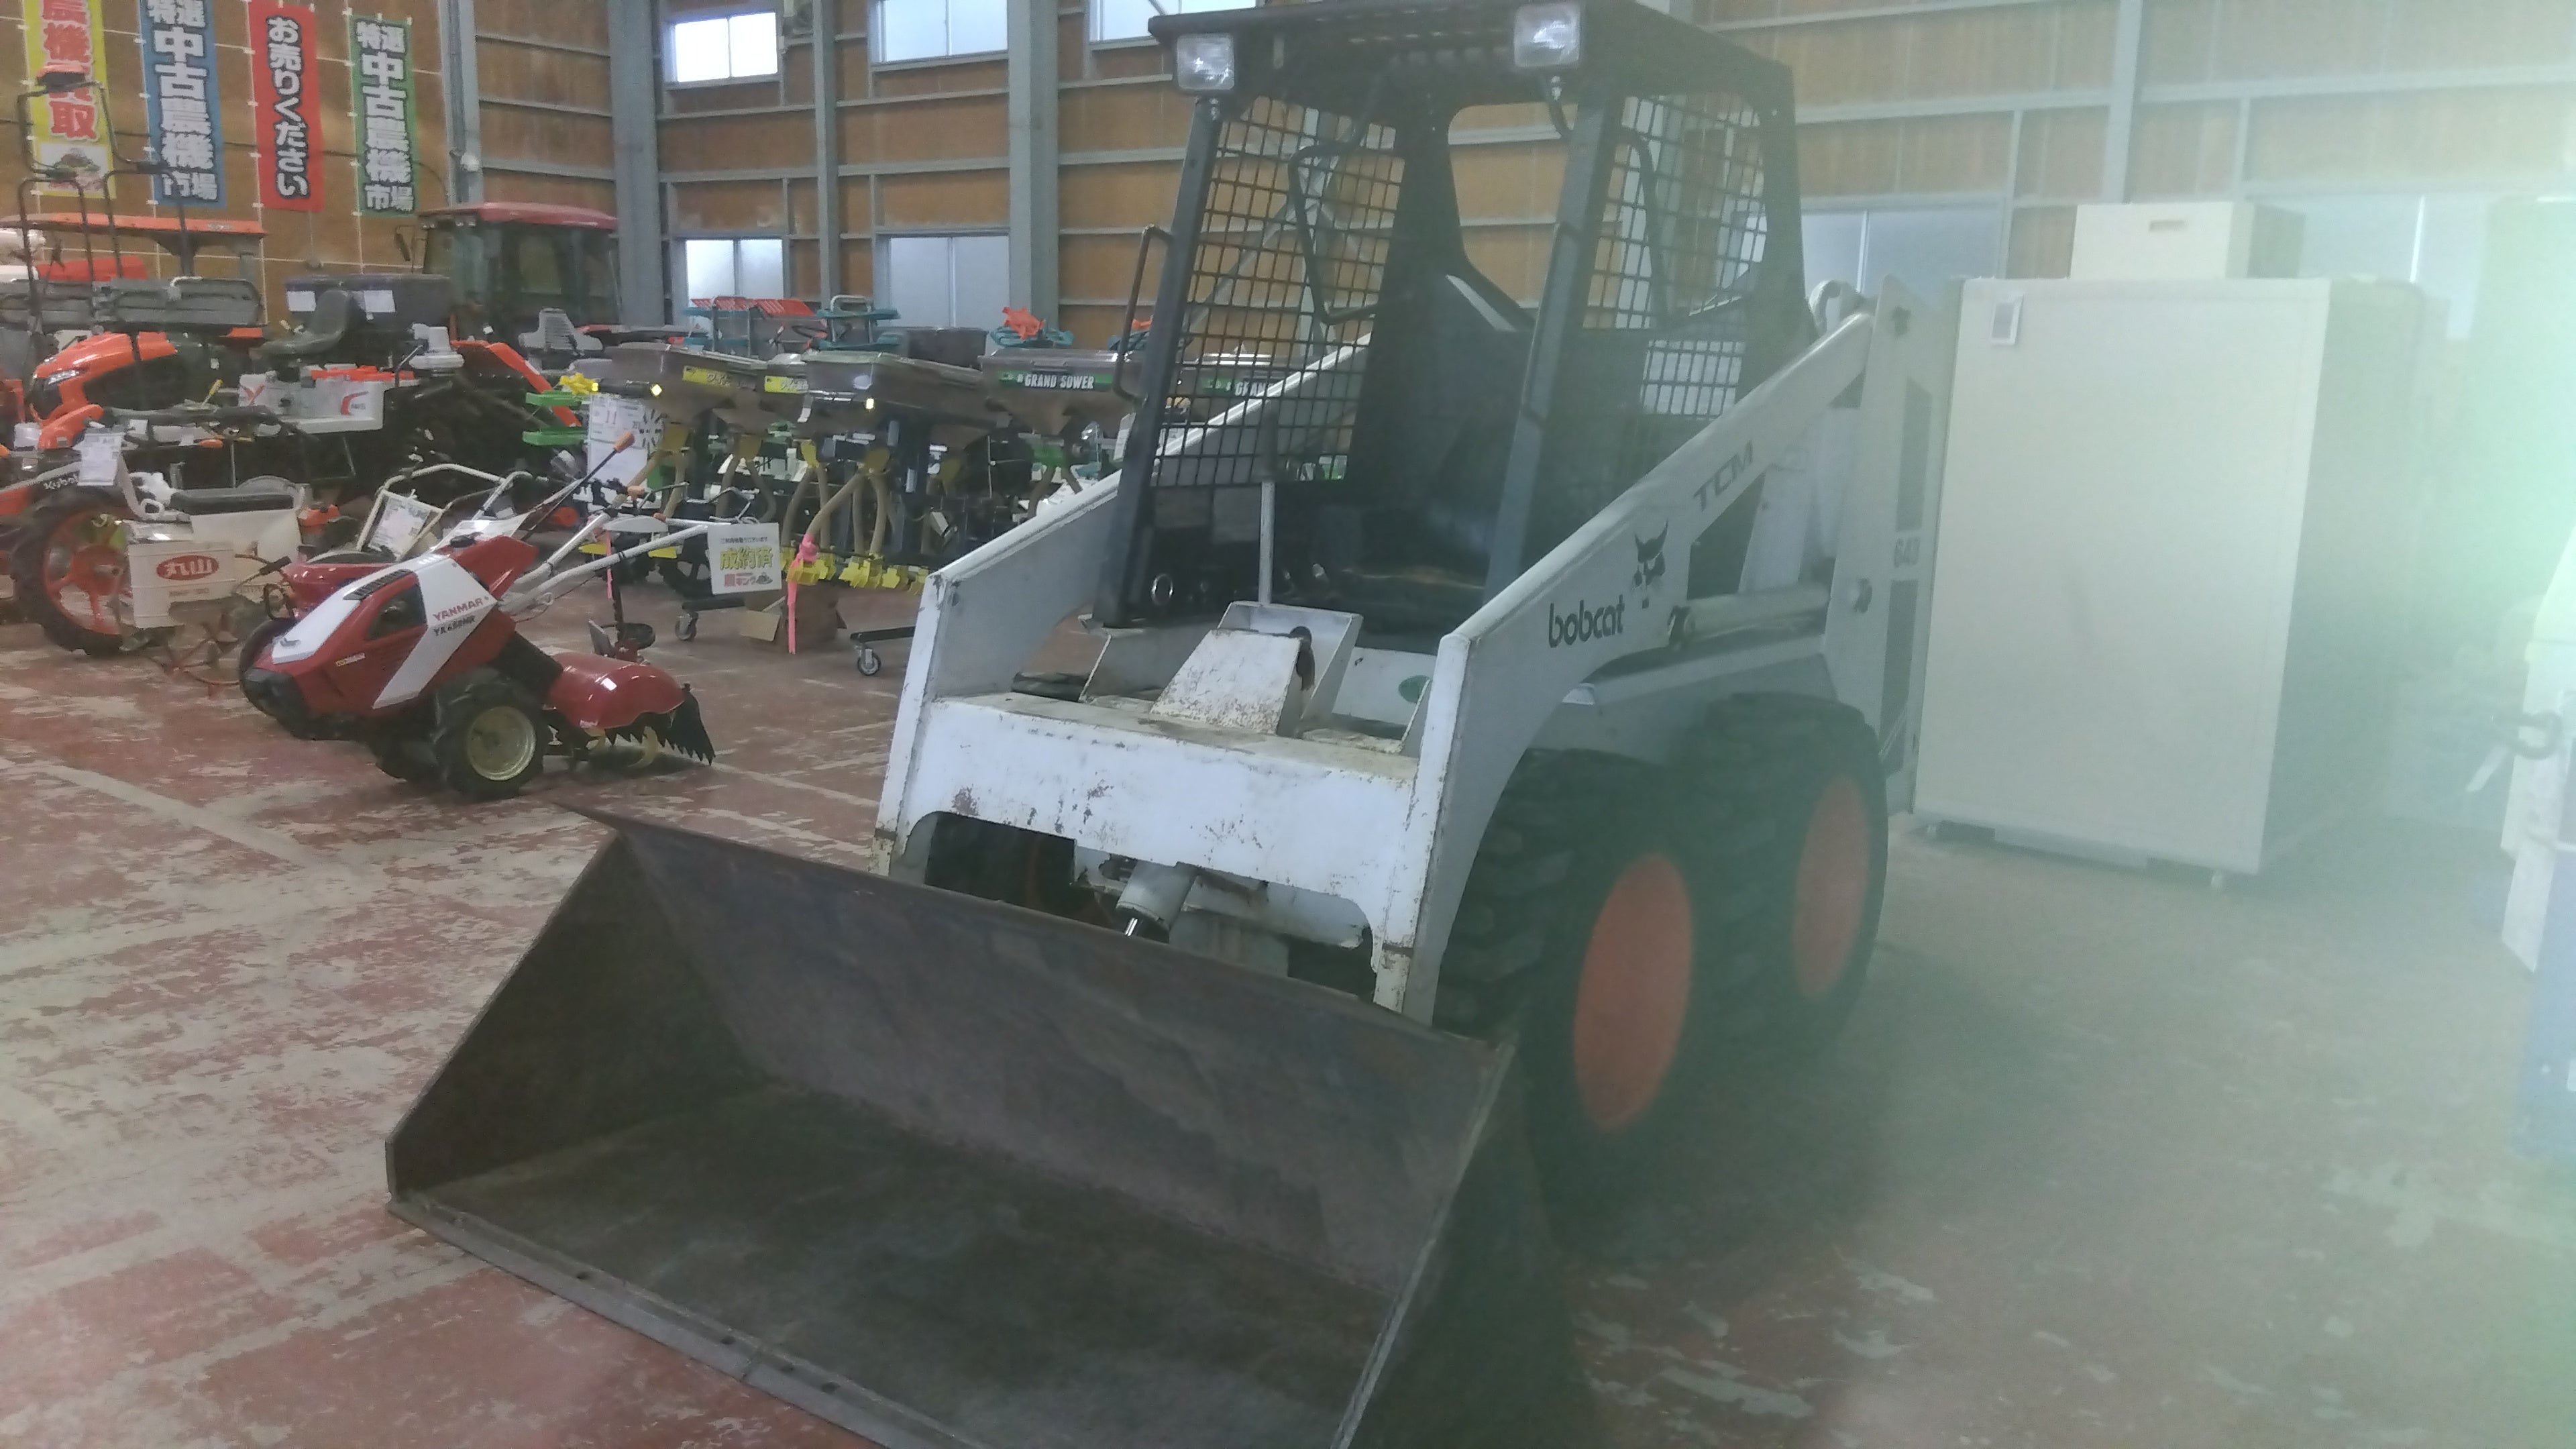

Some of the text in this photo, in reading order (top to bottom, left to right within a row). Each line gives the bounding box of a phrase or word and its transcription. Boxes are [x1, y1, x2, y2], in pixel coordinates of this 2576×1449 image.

[268, 16, 308, 196] お売りください
[1024, 373, 1057, 388] GRAND
[1060, 375, 1095, 390] SOWER
[1234, 380, 1275, 397] GRAN
[1693, 439, 1754, 512] TCM
[720, 546, 773, 570] 成約済
[433, 597, 484, 621] YANMAR
[1548, 594, 1625, 649] bobcat
